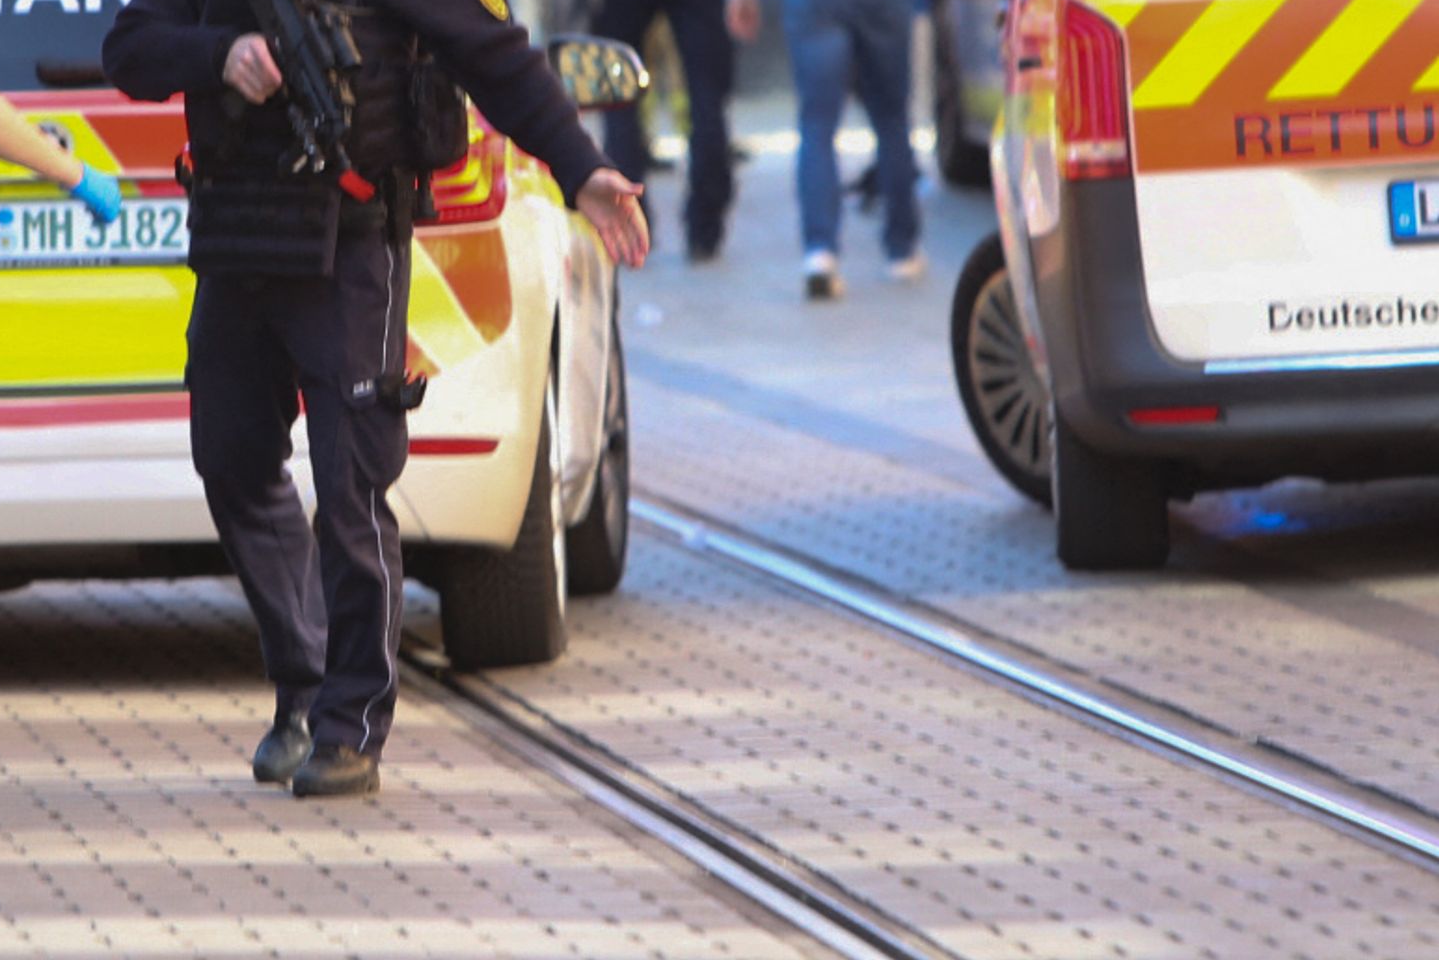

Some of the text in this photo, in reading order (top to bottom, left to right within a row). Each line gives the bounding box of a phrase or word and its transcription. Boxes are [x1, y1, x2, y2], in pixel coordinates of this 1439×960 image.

[1234, 104, 1436, 157] RETTU
[22, 208, 73, 250] MH
[1267, 297, 1439, 331] Deutsche
